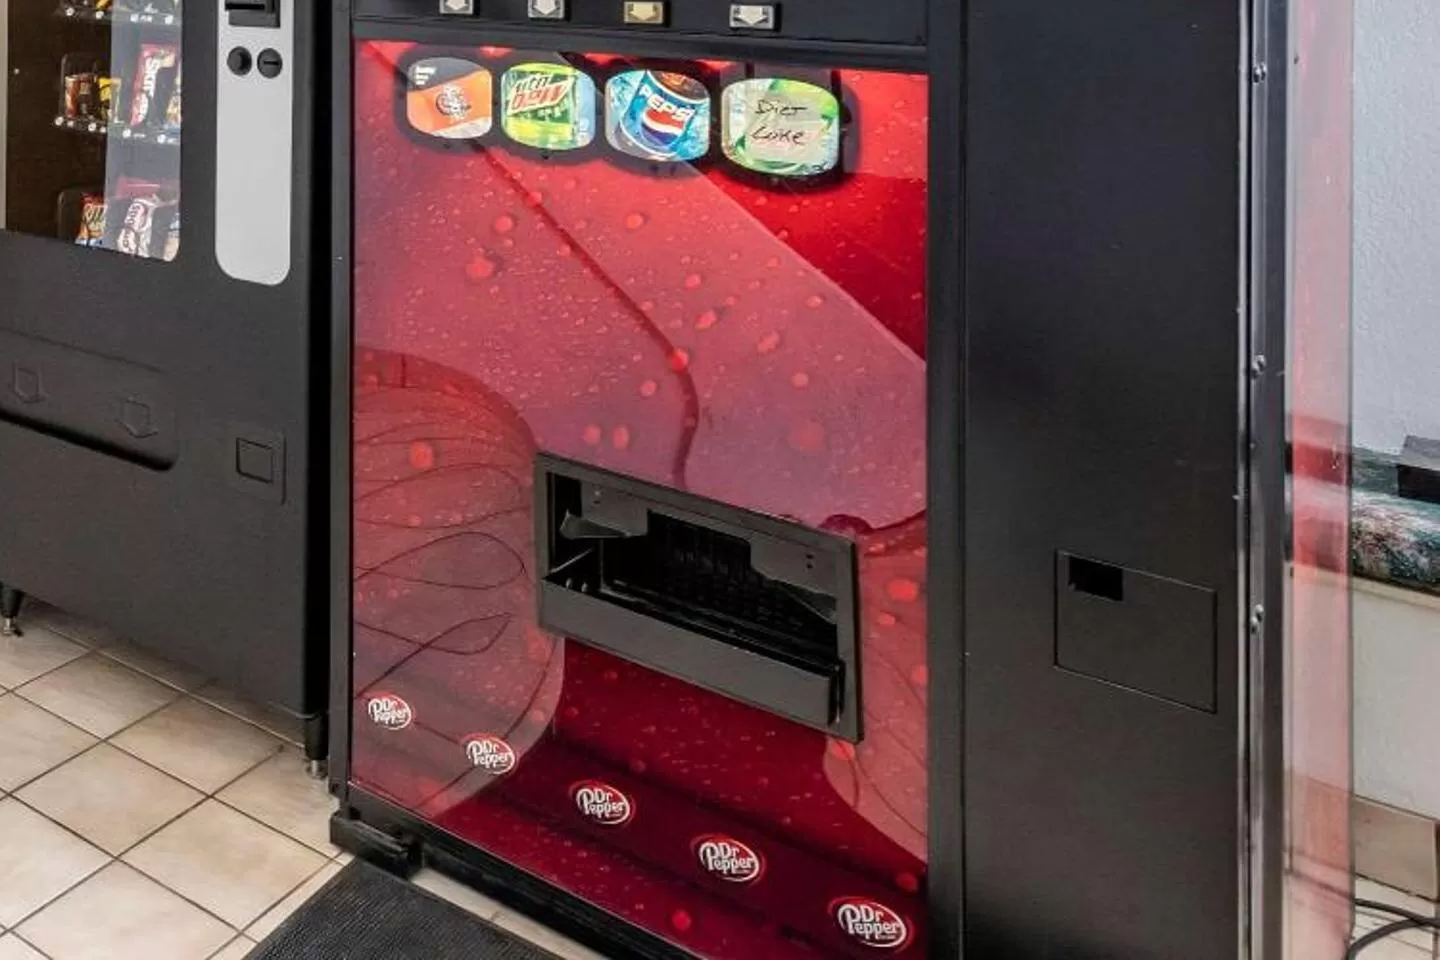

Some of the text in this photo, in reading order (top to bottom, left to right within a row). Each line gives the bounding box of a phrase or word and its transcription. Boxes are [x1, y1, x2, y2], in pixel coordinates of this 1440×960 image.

[368, 698, 409, 725] Pepper
[383, 698, 398, 711] Dr
[466, 740, 511, 769] Pepper
[483, 741, 499, 754] Dr
[576, 788, 624, 819] Pepper
[594, 788, 614, 803] Dr
[699, 843, 754, 874] Pepper
[720, 844, 740, 858] Dr
[838, 903, 901, 940] Pepper
[860, 904, 884, 922] Dr
